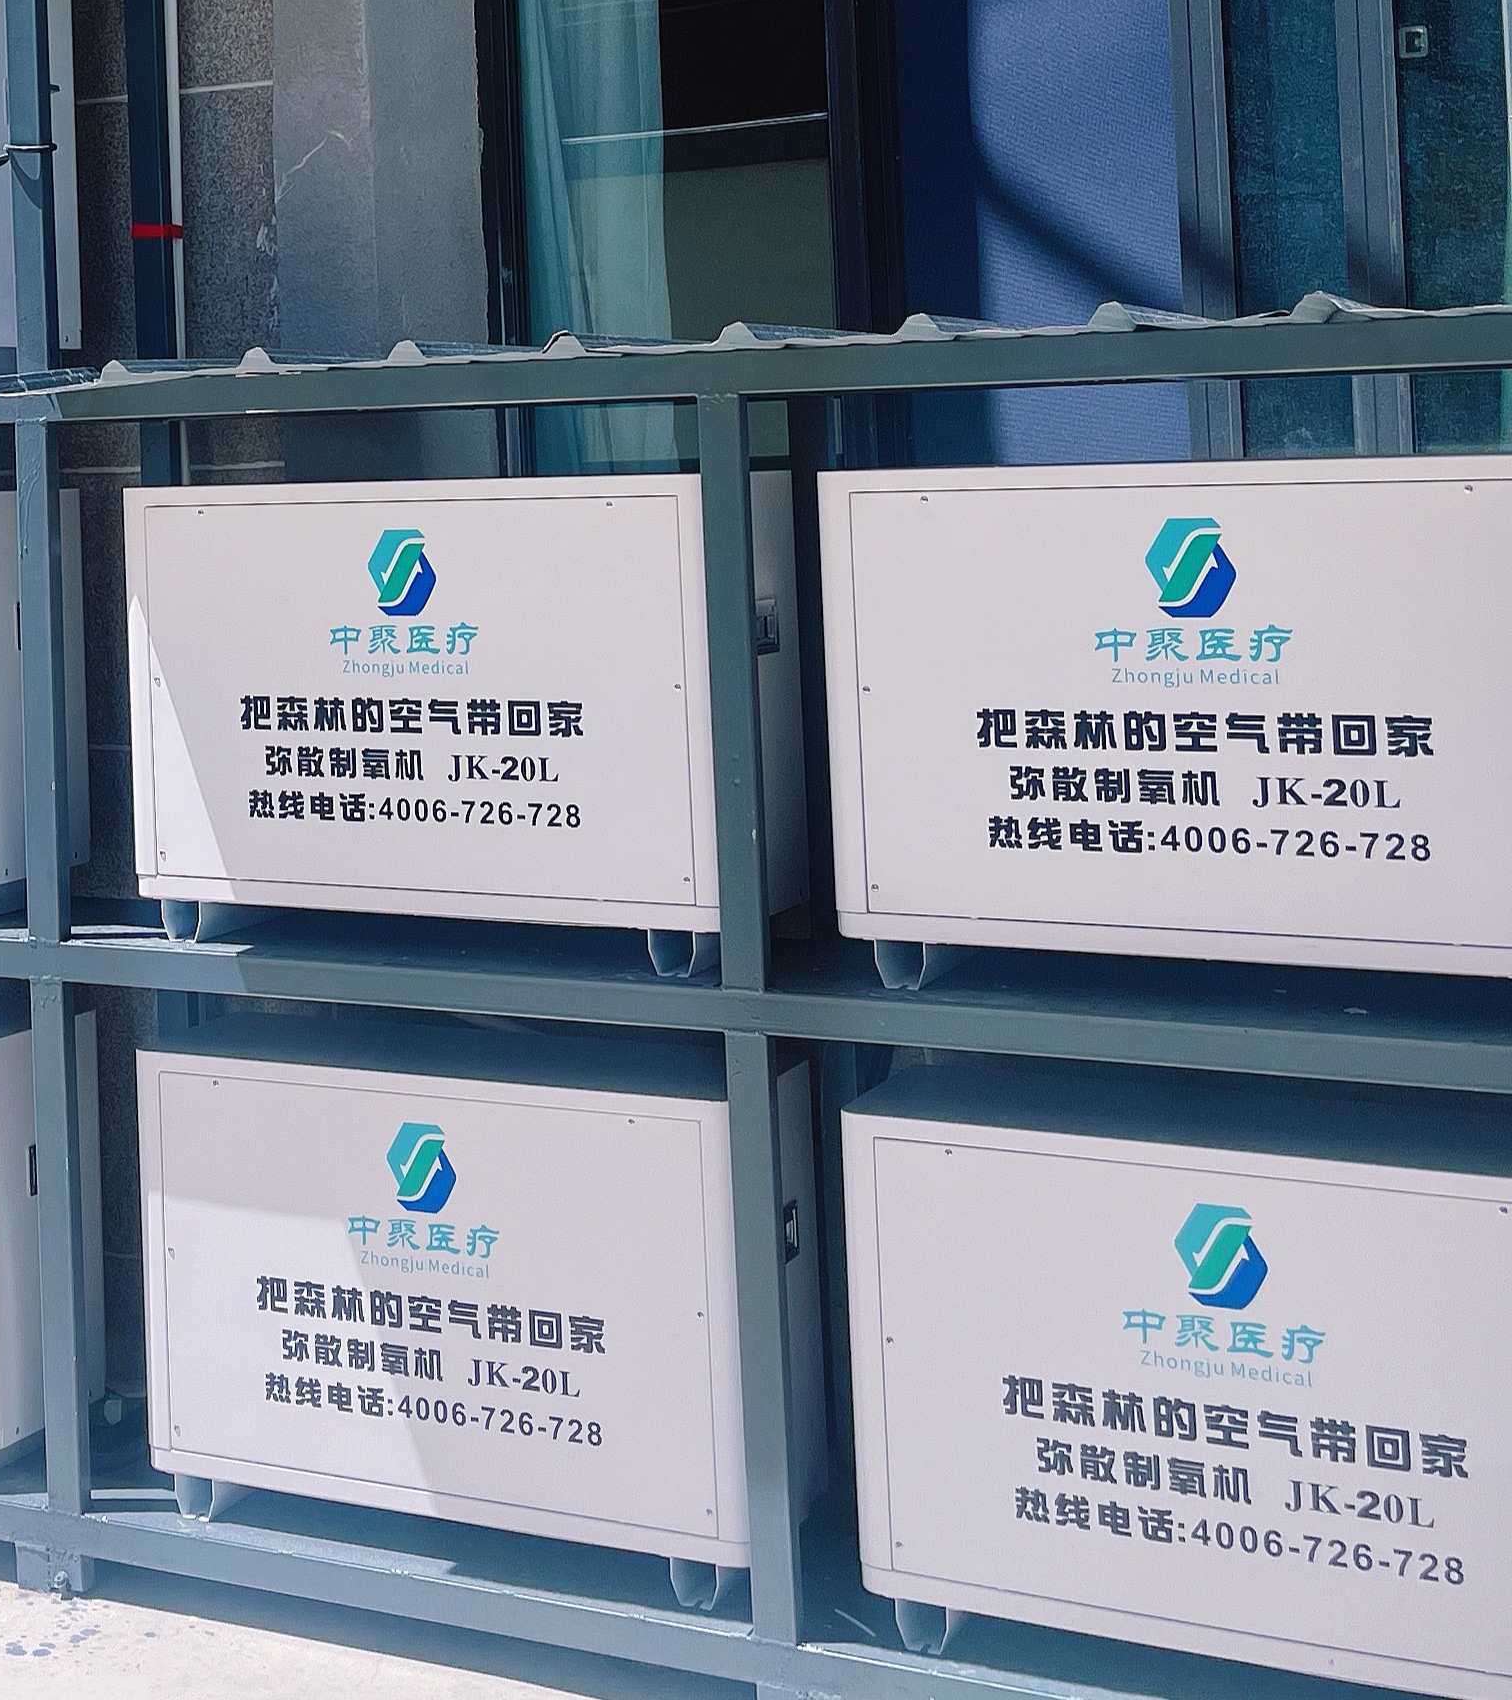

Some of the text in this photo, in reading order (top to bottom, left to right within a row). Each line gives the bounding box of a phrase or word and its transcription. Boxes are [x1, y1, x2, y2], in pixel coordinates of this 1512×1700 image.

[329, 621, 480, 656] 中聚医疗
[1093, 624, 1294, 663] 中聚医疗
[342, 659, 470, 678] Zhongju Medical
[1110, 667, 1281, 688] Zhongju Medical
[240, 694, 584, 738] 把森林的空气带回家
[975, 707, 1435, 758] 把森林的空气带回家
[264, 745, 560, 783] 弥散制氧机 JK-20L
[1008, 766, 1402, 810] 弥散制氧机 JK-20L
[347, 1214, 500, 1259] 中聚医疗
[359, 1250, 491, 1279] Zhongju Medical
[256, 1274, 606, 1355] 把森林的空气带回家
[1122, 1308, 1327, 1365] 中聚医疗
[281, 1328, 582, 1398] 弥散制氧机 JK-20L
[1139, 1349, 1313, 1388] Zhongju Medical
[1001, 1373, 1469, 1480] 把森林的空气带回家
[1035, 1436, 1436, 1529] 弥散制氧机 JK-20L
